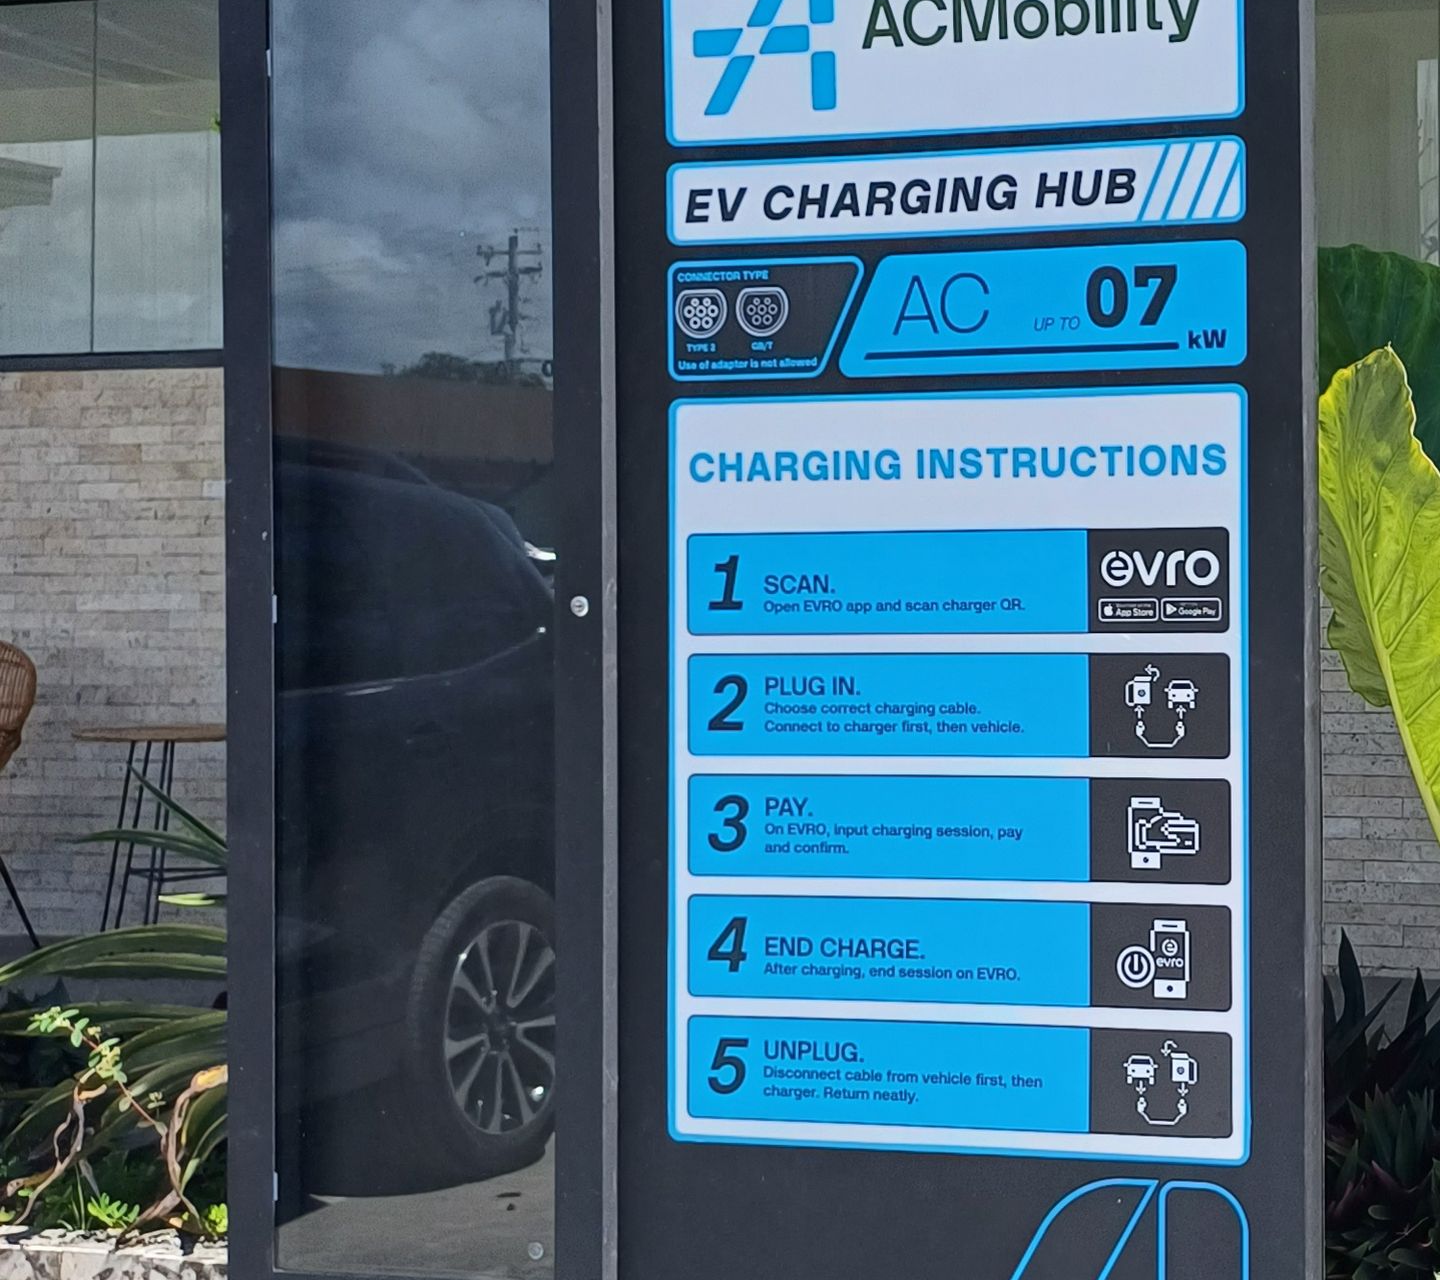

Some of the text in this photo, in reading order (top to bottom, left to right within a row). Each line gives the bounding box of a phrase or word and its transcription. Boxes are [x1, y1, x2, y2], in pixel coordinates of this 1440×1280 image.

[685, 168, 1137, 223] EV CHARGING HUB
[677, 270, 769, 282] CONNECTOR TYPE
[892, 272, 990, 336] AC
[1033, 264, 1227, 350] UP TO 07 kW
[686, 343, 709, 352] TYPE
[678, 361, 697, 370] Use
[699, 360, 710, 370] of
[761, 359, 778, 368] not
[779, 357, 818, 367] allowed
[689, 443, 1228, 483] CHARGING INSTRUCTIONS
[1101, 550, 1220, 587] evro
[708, 555, 744, 611] 1
[763, 574, 836, 595] SCAN.
[763, 598, 1026, 613] Open EVRO app and scan charger QR.
[1115, 607, 1154, 617] App Store
[1178, 606, 1216, 616] Google Play
[764, 675, 861, 696] PLUG IN.
[707, 674, 748, 731] 2
[764, 702, 982, 718] Choose correct charging cable.
[764, 719, 1025, 736] Connect to charger first, then vehicle.
[764, 797, 814, 817] PAY.
[708, 794, 750, 853] 3
[764, 823, 1024, 841] On EVRO, input charging session, pay
[764, 841, 850, 855] and confirm.
[707, 916, 748, 973] 4
[764, 936, 926, 960] END CHARGE.
[764, 962, 1021, 981] After charging, end session on EVRO.
[1156, 957, 1184, 968] evro
[763, 1040, 865, 1063] UNPLUG.
[707, 1037, 749, 1095] 5
[763, 1065, 1043, 1088] Disconnect cable from vehicle first, then
[763, 1085, 919, 1104] charger. Return neatly.
